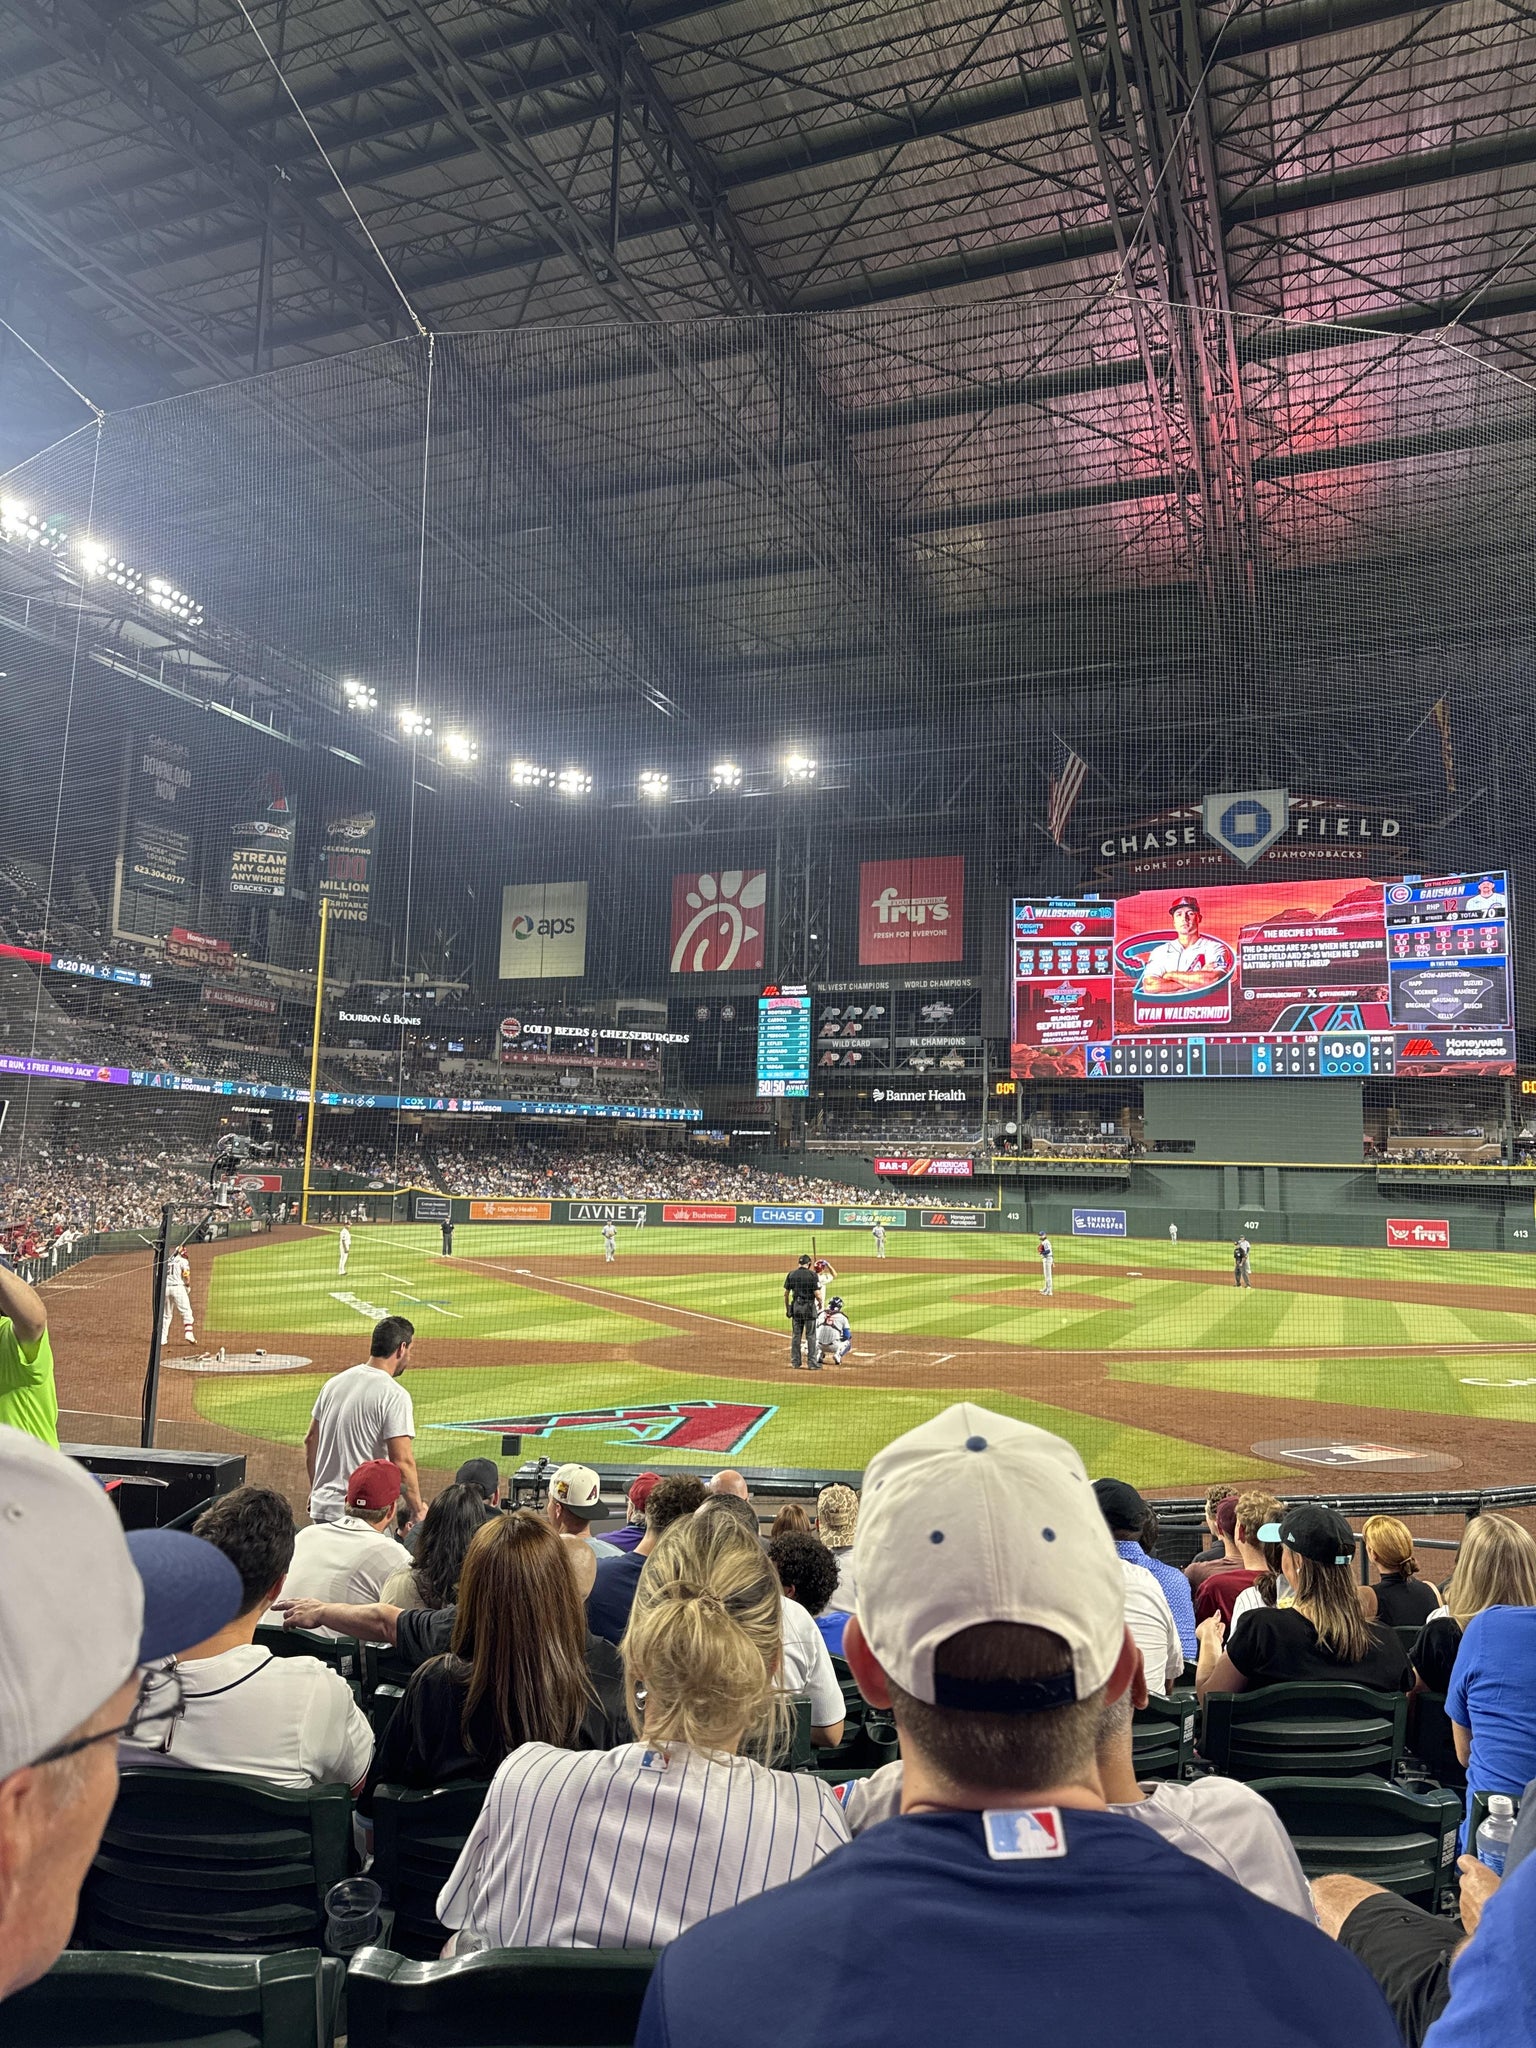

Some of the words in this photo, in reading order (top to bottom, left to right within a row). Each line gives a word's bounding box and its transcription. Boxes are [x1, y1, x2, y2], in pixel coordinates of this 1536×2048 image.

[1100, 827, 1196, 857] CHASE
[1297, 818, 1401, 837] FIELD
[322, 844, 371, 855] CELEBRATING
[232, 851, 287, 866] STREAM
[1134, 861, 1168, 873] HOME
[1176, 858, 1192, 867] OF
[1200, 855, 1223, 865] THE
[1269, 850, 1363, 859] DIAMONDBACKS
[134, 864, 185, 884] 623.304.0777
[231, 863, 254, 873] ANY
[256, 865, 286, 875] GAME
[230, 873, 286, 885] ANYWHERE
[319, 880, 370, 892] MILLION
[1419, 885, 1466, 899] GAUSMAN
[871, 887, 949, 925] fry's
[1426, 903, 1440, 911] RHP
[1443, 899, 1458, 912] 12
[1035, 908, 1090, 918] WALDSCHMIDT
[1411, 916, 1420, 924] 21
[1446, 912, 1459, 920] 49
[1481, 908, 1496, 918] 70
[537, 915, 575, 940] aps
[912, 929, 947, 937] EVERYONE
[1263, 930, 1278, 938] THE
[1279, 929, 1305, 937] RECIPE
[1306, 928, 1313, 936] IS
[1314, 927, 1344, 936] THERE...
[187, 932, 217, 947] Honeywell
[1256, 945, 1286, 953] D-BACKS
[1286, 944, 1299, 952] ARE
[1349, 941, 1374, 949] STARTS
[1375, 940, 1383, 948] IN
[169, 942, 236, 967] SANDLOT
[1242, 953, 1267, 961] CENTER
[1268, 952, 1286, 960] FIELD
[1287, 952, 1301, 960] AND
[57, 958, 78, 971] 8:20
[79, 962, 95, 975] PM
[1242, 961, 1271, 969] BATTING
[1306, 959, 1330, 967] LINEUP
[848, 982, 889, 990] CHAMPIONS
[904, 980, 928, 988] WORLD
[929, 979, 971, 987] CHAMPIONS
[253, 998, 268, 1009] SEATS
[339, 1011, 381, 1023] BOURBON
[382, 1013, 391, 1024] &
[393, 1014, 421, 1026] BONES
[1138, 1007, 1163, 1020] RYAN
[1164, 1006, 1230, 1019] WALDSCHMIDT
[1036, 1020, 1081, 1031] SEPTEMBER
[1082, 1020, 1094, 1028] 27
[523, 1024, 552, 1035] COLD
[554, 1026, 590, 1037] BEERS
[591, 1028, 598, 1037] &
[600, 1029, 690, 1044] CHEESEBURGERS
[851, 1039, 871, 1047] CARD
[910, 1038, 920, 1046] NL
[921, 1037, 966, 1046] CHAMPIONS
[1445, 1037, 1503, 1049] Honeywell
[1114, 1049, 1122, 1059] 0
[1130, 1049, 1136, 1059] 1
[1145, 1049, 1153, 1059] 0
[1160, 1048, 1168, 1059] 0
[1177, 1048, 1183, 1058] 1
[1192, 1048, 1200, 1058] 3
[1257, 1047, 1266, 1057] 5
[1275, 1047, 1284, 1057] 7
[1291, 1047, 1299, 1057] 0
[1307, 1046, 1316, 1056] 5
[1324, 1045, 1331, 1055] B
[1331, 1042, 1344, 1058] 0
[1345, 1045, 1352, 1055] S
[1353, 1041, 1366, 1058] 0
[1445, 1047, 1507, 1057] Aerospace
[8, 1060, 26, 1071] RUN,
[32, 1063, 50, 1072] FREE
[50, 1065, 74, 1075] JUMBO
[1257, 1062, 1266, 1073] 0
[1275, 1062, 1283, 1072] 2
[1291, 1062, 1300, 1072] 0
[1308, 1061, 1315, 1071] 1
[759, 1080, 771, 1092] 50
[773, 1080, 785, 1092] 50
[995, 1082, 1015, 1095] 0:09
[886, 1090, 930, 1101] Banner
[931, 1089, 966, 1101] Health
[404, 1098, 424, 1106] COX
[878, 1161, 908, 1171] BAR-S
[953, 1167, 970, 1175] DOG
[497, 1205, 517, 1214] Dignity
[518, 1205, 538, 1213] Health
[577, 1206, 639, 1219] AVNET
[691, 1211, 728, 1219] Budweiser
[761, 1210, 803, 1221] CHASE
[738, 1216, 751, 1224] 374
[1007, 1212, 1020, 1220] 413
[1244, 1221, 1259, 1229] 407
[1411, 1225, 1447, 1242] fry's
[1513, 1230, 1529, 1238] 413
